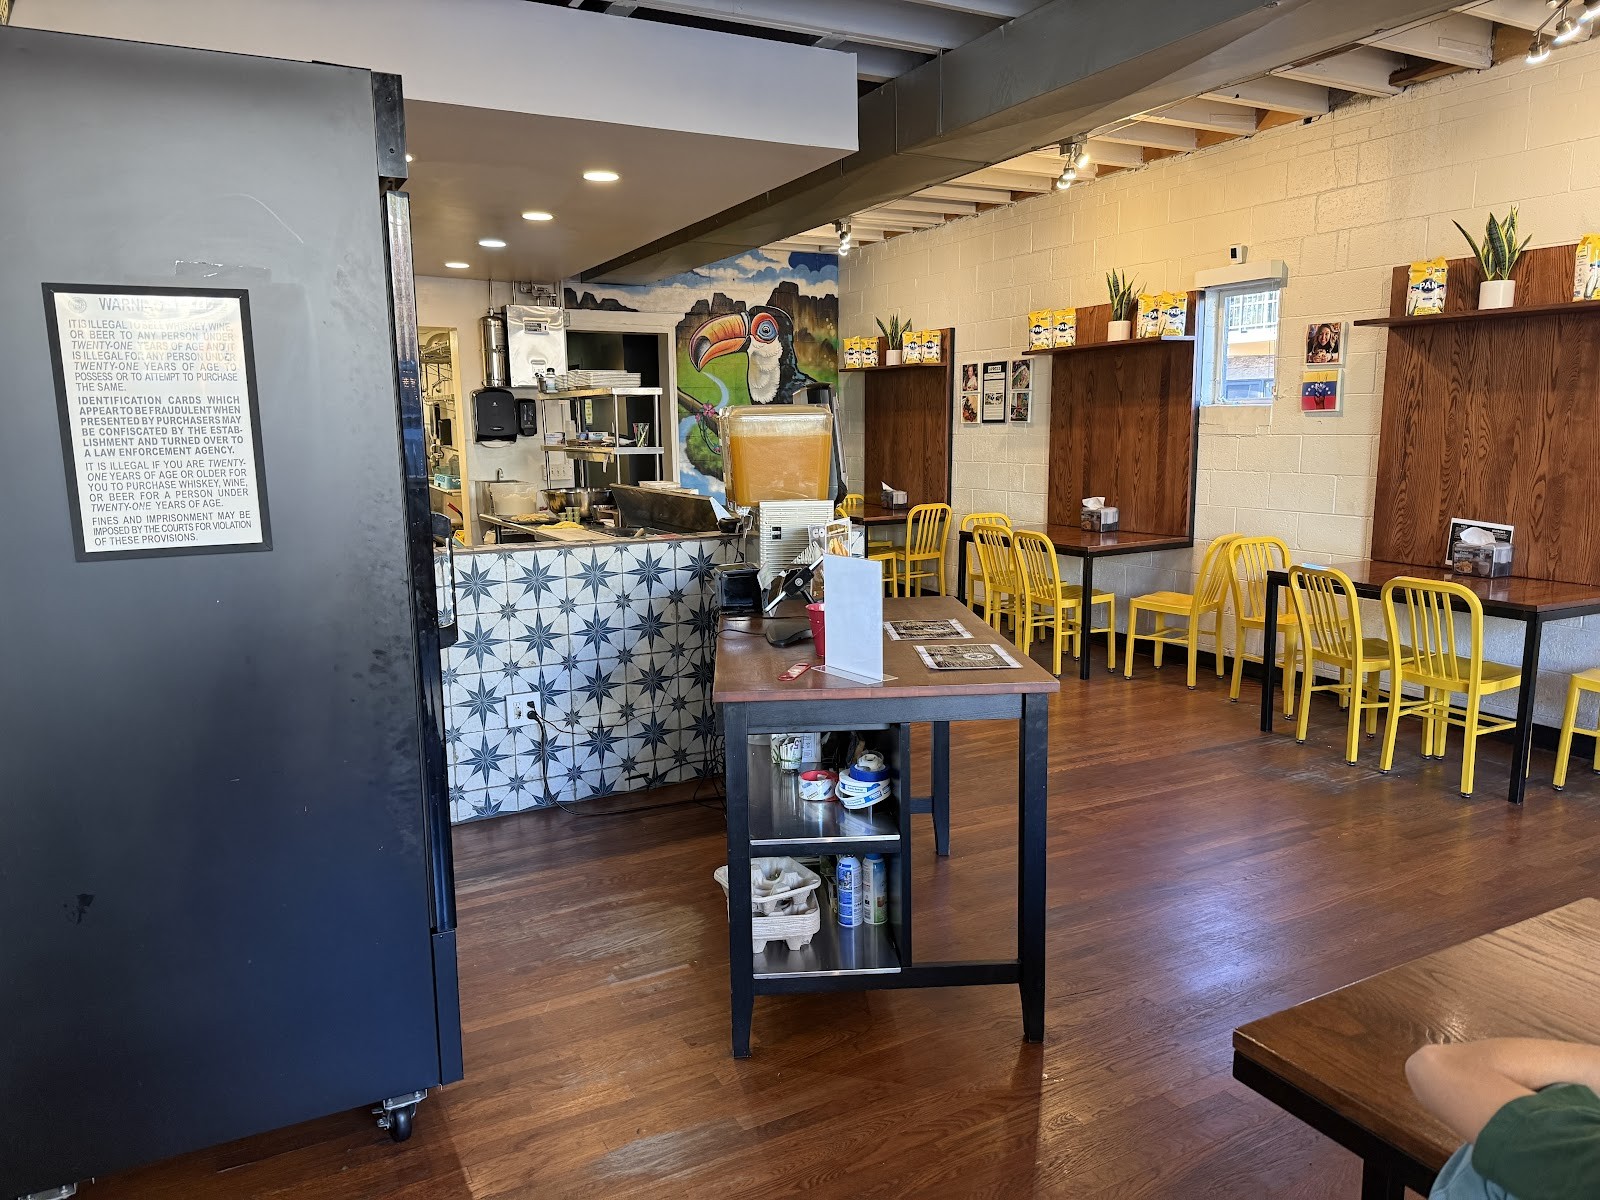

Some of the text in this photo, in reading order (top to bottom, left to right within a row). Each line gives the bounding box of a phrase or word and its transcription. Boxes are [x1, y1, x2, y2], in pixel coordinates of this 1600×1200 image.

[1420, 281, 1438, 289] PAN
[99, 298, 164, 312] WARNI
[1167, 307, 1180, 315] PAN
[68, 319, 78, 327] IT
[78, 319, 86, 327] IS
[88, 319, 127, 328] ILLEGAL
[69, 330, 233, 341] OR BEER TO ANY PERSON UNDER
[72, 340, 133, 350] TWENTY-ONE
[171, 342, 183, 350] OF
[185, 342, 204, 350] AGE
[72, 351, 81, 359] IS
[83, 351, 122, 360] ILLEGAL
[146, 352, 164, 360] ANY
[166, 352, 203, 360] PERSON
[206, 352, 236, 361] UNDER
[74, 361, 236, 371] TWENTY-ONE YEARS OF AGE TO
[74, 372, 237, 381] POSSESS OR TO ATTEMPT TO PURCHASE
[76, 382, 126, 392] THE SAME.
[78, 396, 162, 404] IDENTIFICATION
[79, 405, 240, 415] APPEAR TO BE FRAUDULENT WHEN
[80, 415, 242, 426] PRESENTED BY PURCHASERS MAY
[82, 425, 243, 436] BE CONFISCATED BY THE ESTAB-
[83, 435, 244, 446] LISHMENT AND TURNED OVER TO
[84, 445, 234, 457] A LAW ENFORCEMENT AGENCY.
[85, 458, 246, 471] IT IS ILLEGAL IF YOU ARE TWENTY-
[87, 468, 246, 481] ONE YEARS OF AGE OR OLDER FOR
[88, 478, 247, 491] YOU TO PURCHASE WHISKEY, WINE,
[89, 488, 248, 502] OR BEER FOR A PERSON UNDER
[91, 498, 223, 512] TWENTY-ONE YEARS OF AGE.
[92, 510, 250, 526] FINES AND IMPRISONMENT MAY BE
[93, 520, 251, 536] IMPOSED BY THE COURTS FOR VIOLATION
[94, 532, 198, 546] OF THESE PROVISIONS.
